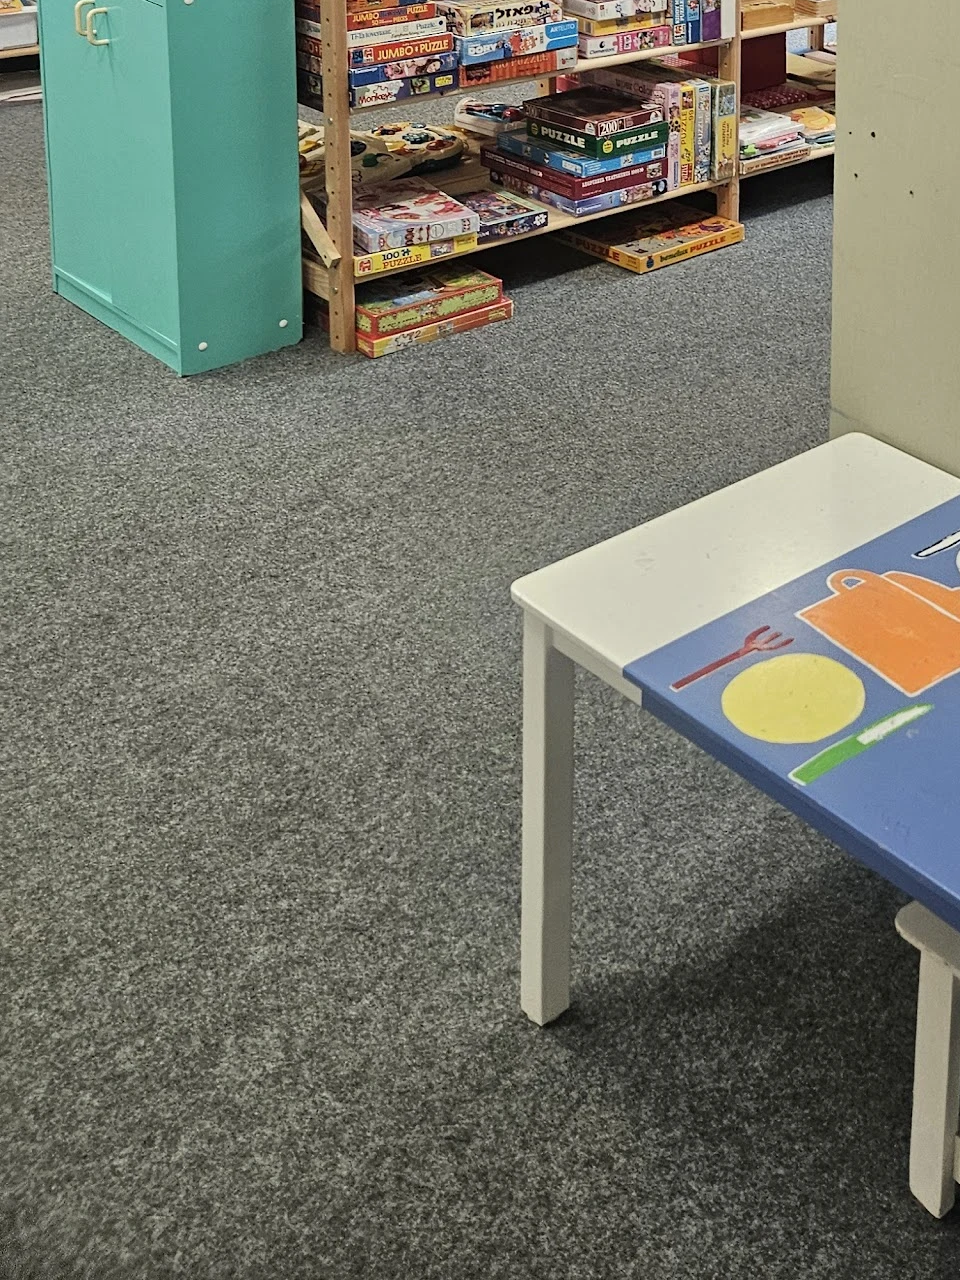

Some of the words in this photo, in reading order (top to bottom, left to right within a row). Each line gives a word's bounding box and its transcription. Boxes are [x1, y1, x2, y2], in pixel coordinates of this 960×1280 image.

[352, 12, 380, 23] JUMBO
[406, 4, 428, 14] PUZZLE
[495, 5, 534, 20] פאזל
[377, 46, 414, 60] JUMBO
[420, 40, 448, 52] PUZZLE
[467, 44, 498, 56] DORY
[510, 54, 549, 67] PUZZLE
[358, 92, 393, 105] Monkeys
[600, 122, 618, 136] 200
[541, 127, 586, 149] PUZZLE
[616, 131, 658, 148] PUZZLE
[382, 249, 400, 262] 100
[575, 238, 620, 262] PUZZLE
[659, 248, 688, 263] benelux
[689, 236, 726, 253] PUZZLE
[382, 254, 422, 270] PUZZLE
